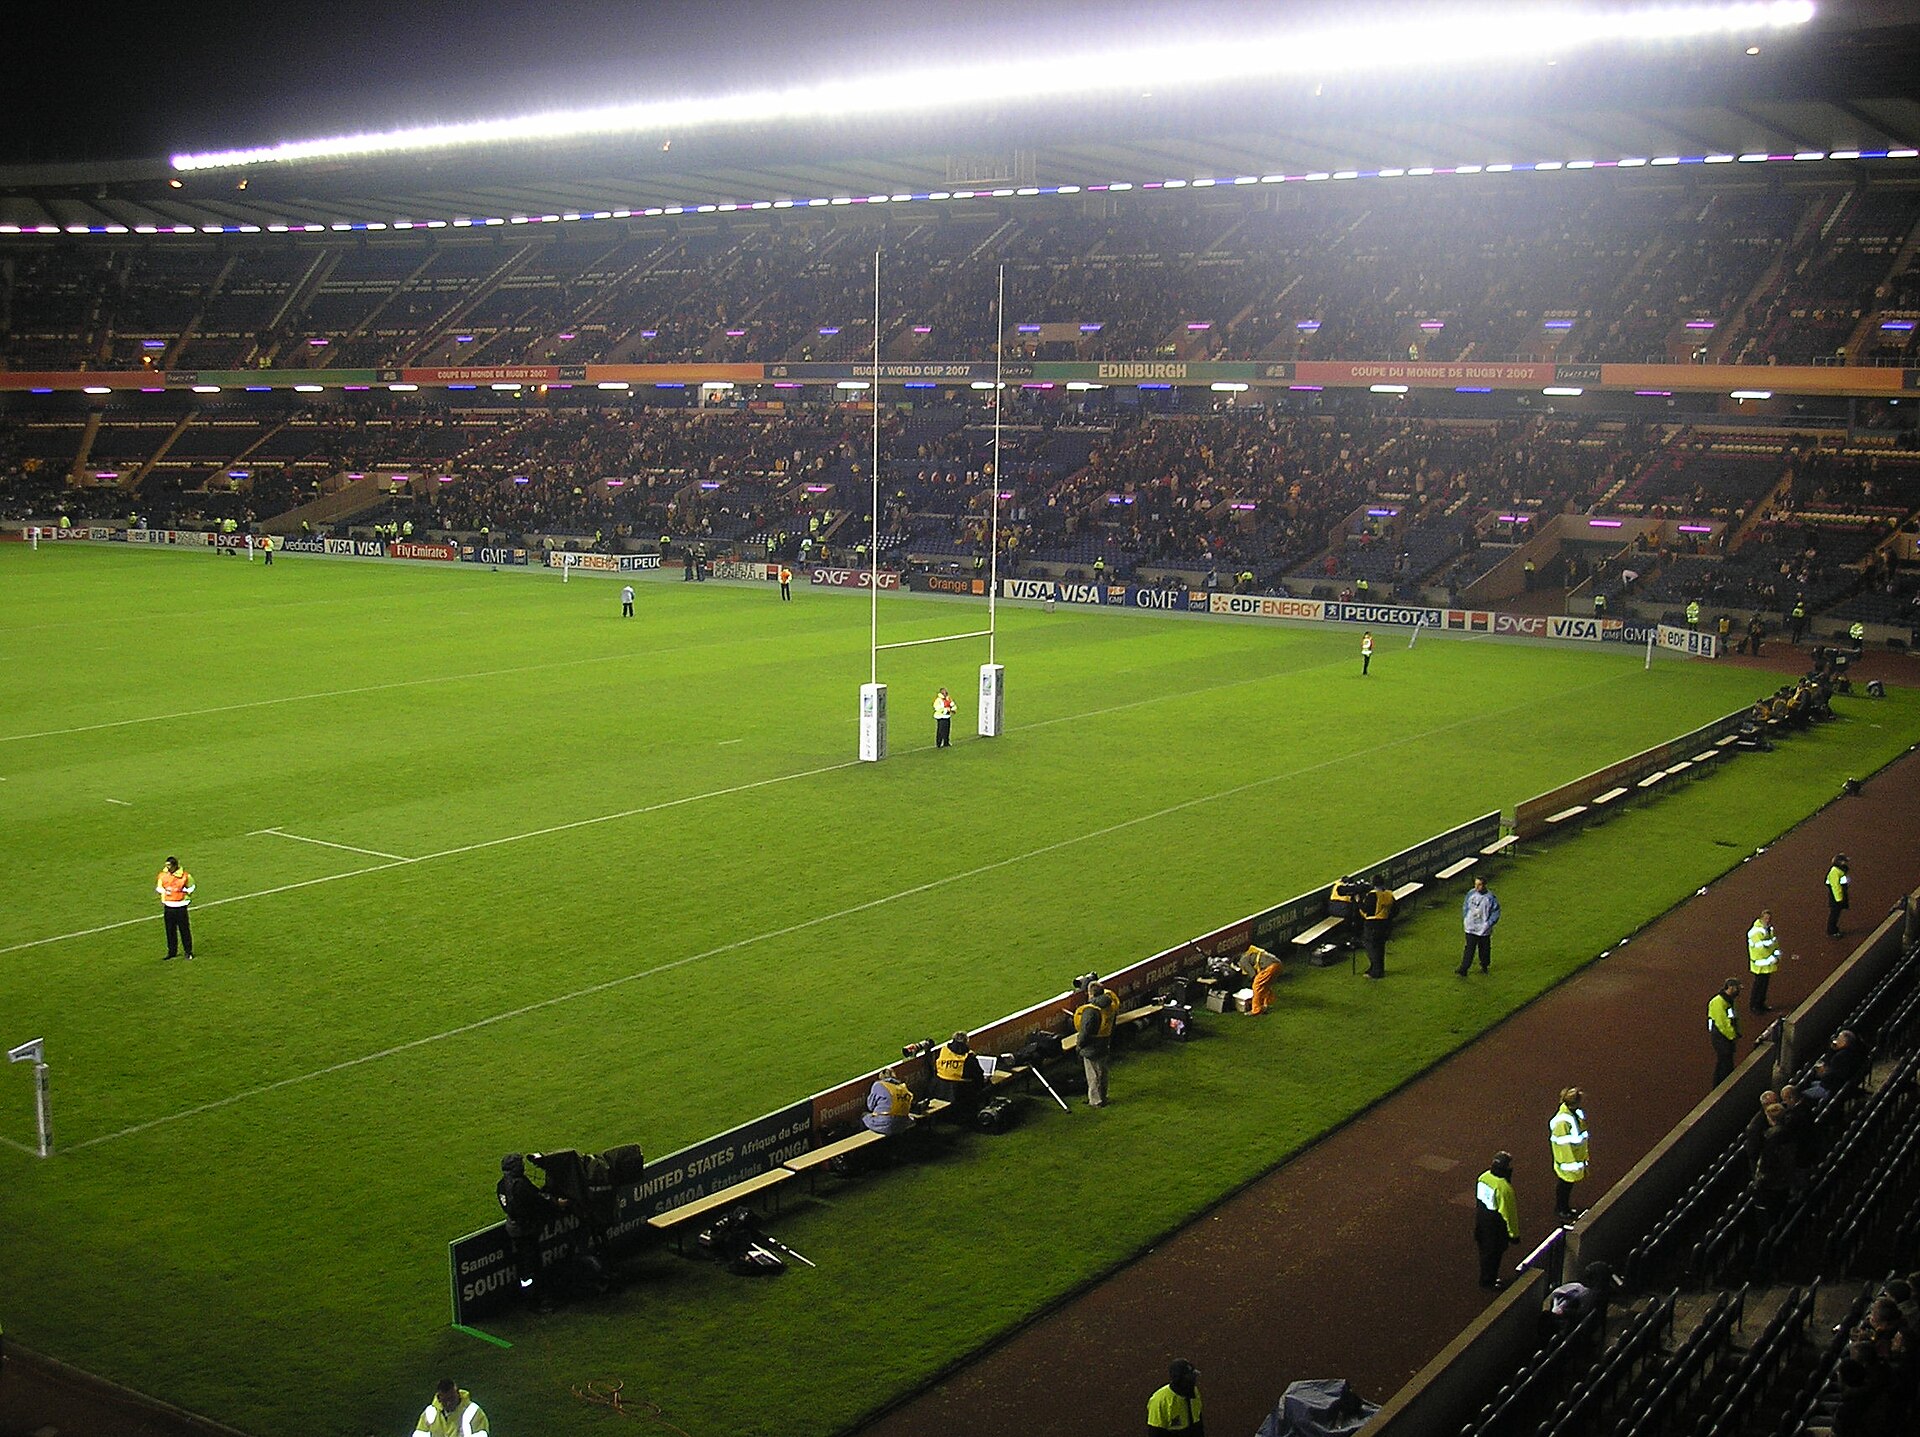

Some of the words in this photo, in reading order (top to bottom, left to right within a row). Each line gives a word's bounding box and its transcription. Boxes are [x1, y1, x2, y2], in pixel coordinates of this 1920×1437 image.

[438, 371, 459, 379] COUPE
[471, 371, 494, 379] MONDE
[530, 370, 547, 378] 2007
[853, 366, 886, 376] RUGBY
[887, 366, 921, 376] WORLD
[924, 366, 944, 376] CUP
[946, 366, 971, 376] 2007
[1099, 364, 1187, 378] EDINBURGH
[1351, 367, 1386, 377] COUPE
[1389, 367, 1404, 377] DU
[1407, 367, 1446, 377] MONDE
[1449, 367, 1463, 378] DE
[1466, 368, 1503, 378] RUGBY
[1506, 368, 1534, 379] 2007
[58, 529, 88, 539] SNCF
[217, 534, 241, 547] SNCF
[284, 540, 324, 552] vediorbis
[329, 540, 353, 554] VISA
[357, 541, 382, 556] VISA
[397, 544, 410, 558] Fly
[412, 545, 448, 559] Emirates
[481, 547, 508, 564] GMF
[812, 569, 850, 584] SNCF
[857, 572, 898, 588] SNCF
[929, 576, 967, 593] Orange
[1010, 581, 1049, 600] VISA
[1058, 584, 1100, 604] VISA
[1136, 589, 1179, 609] GMF
[1262, 600, 1321, 617] ENERGY
[1345, 606, 1422, 626] PEUGEOT
[1495, 616, 1546, 633] SNCF
[1553, 619, 1597, 639] VISA
[633, 1168, 683, 1202] UNITED
[687, 1147, 735, 1179] STATES
[741, 1134, 777, 1157] Afrique
[778, 1128, 791, 1140] du
[792, 1118, 811, 1134] Sud
[768, 1137, 810, 1167] TONGA
[460, 1249, 504, 1275] Samoa
[463, 1264, 518, 1302] SOUTH
